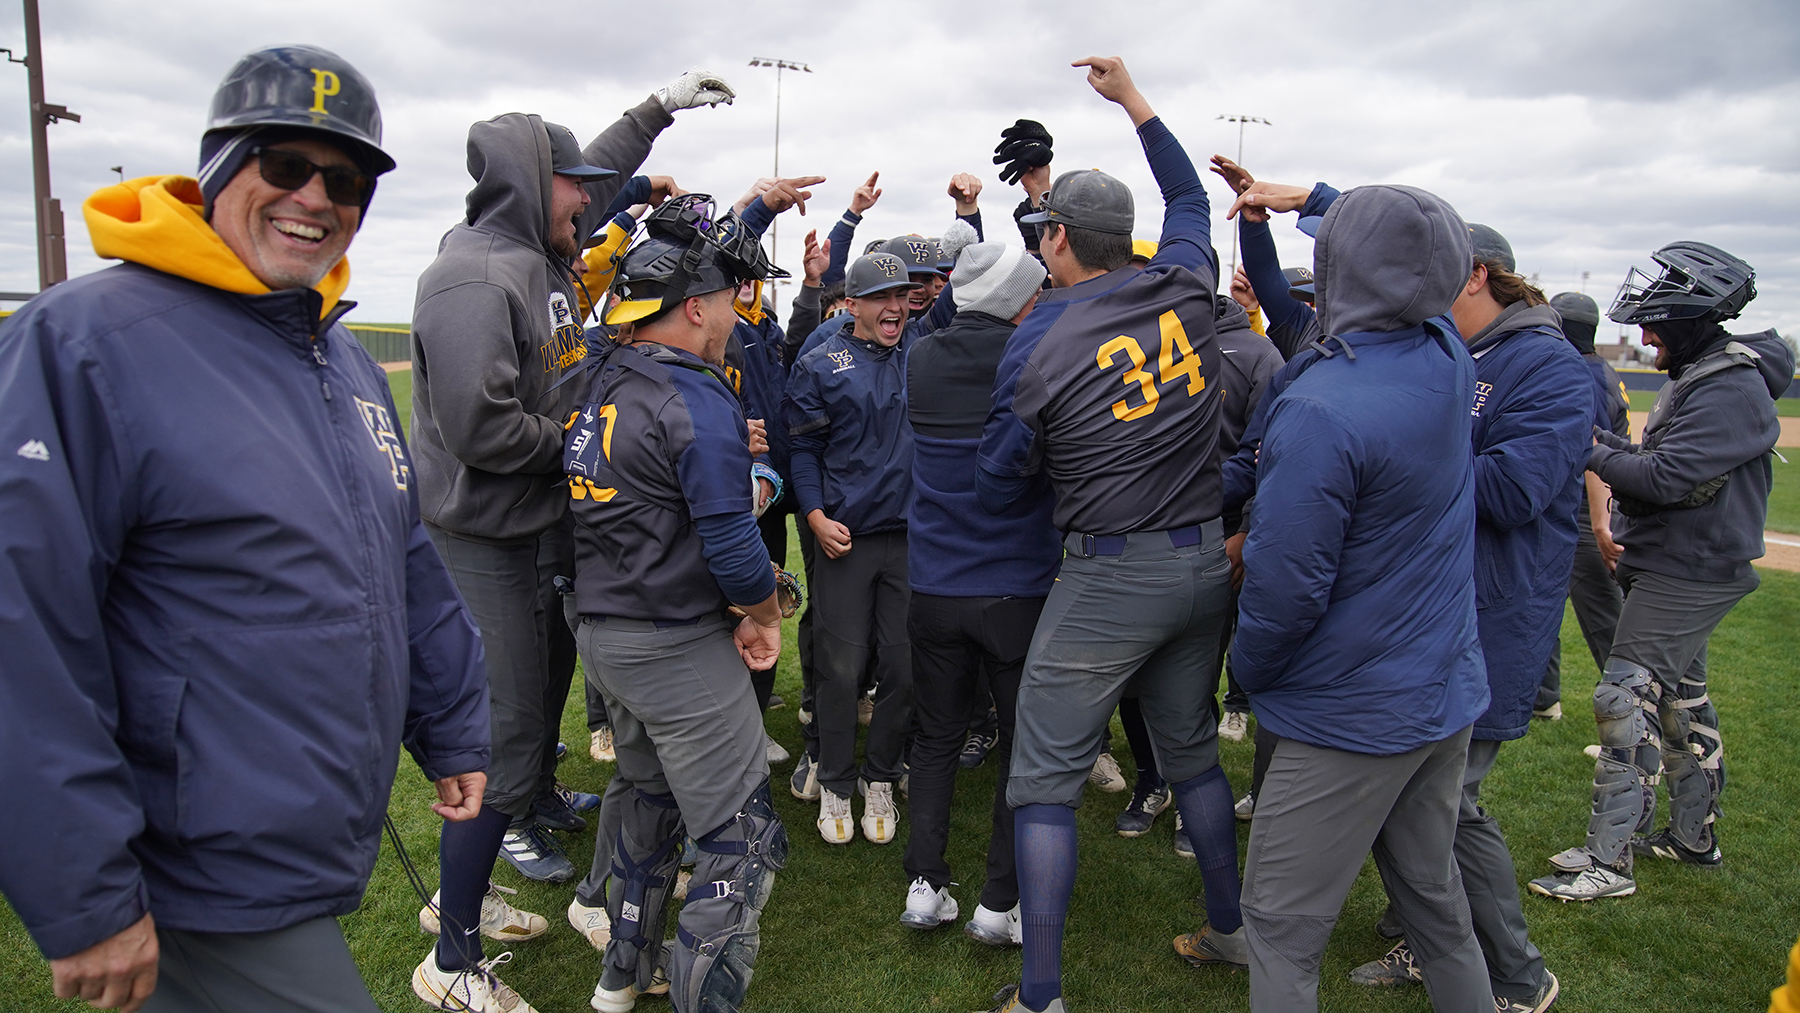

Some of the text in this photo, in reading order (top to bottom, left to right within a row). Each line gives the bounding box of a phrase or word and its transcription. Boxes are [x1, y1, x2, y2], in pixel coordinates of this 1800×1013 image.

[308, 68, 341, 115] P
[873, 257, 899, 278] WP
[907, 241, 930, 264] WP
[827, 349, 853, 368] WP
[1095, 308, 1206, 422] 34
[352, 394, 409, 491] WP
